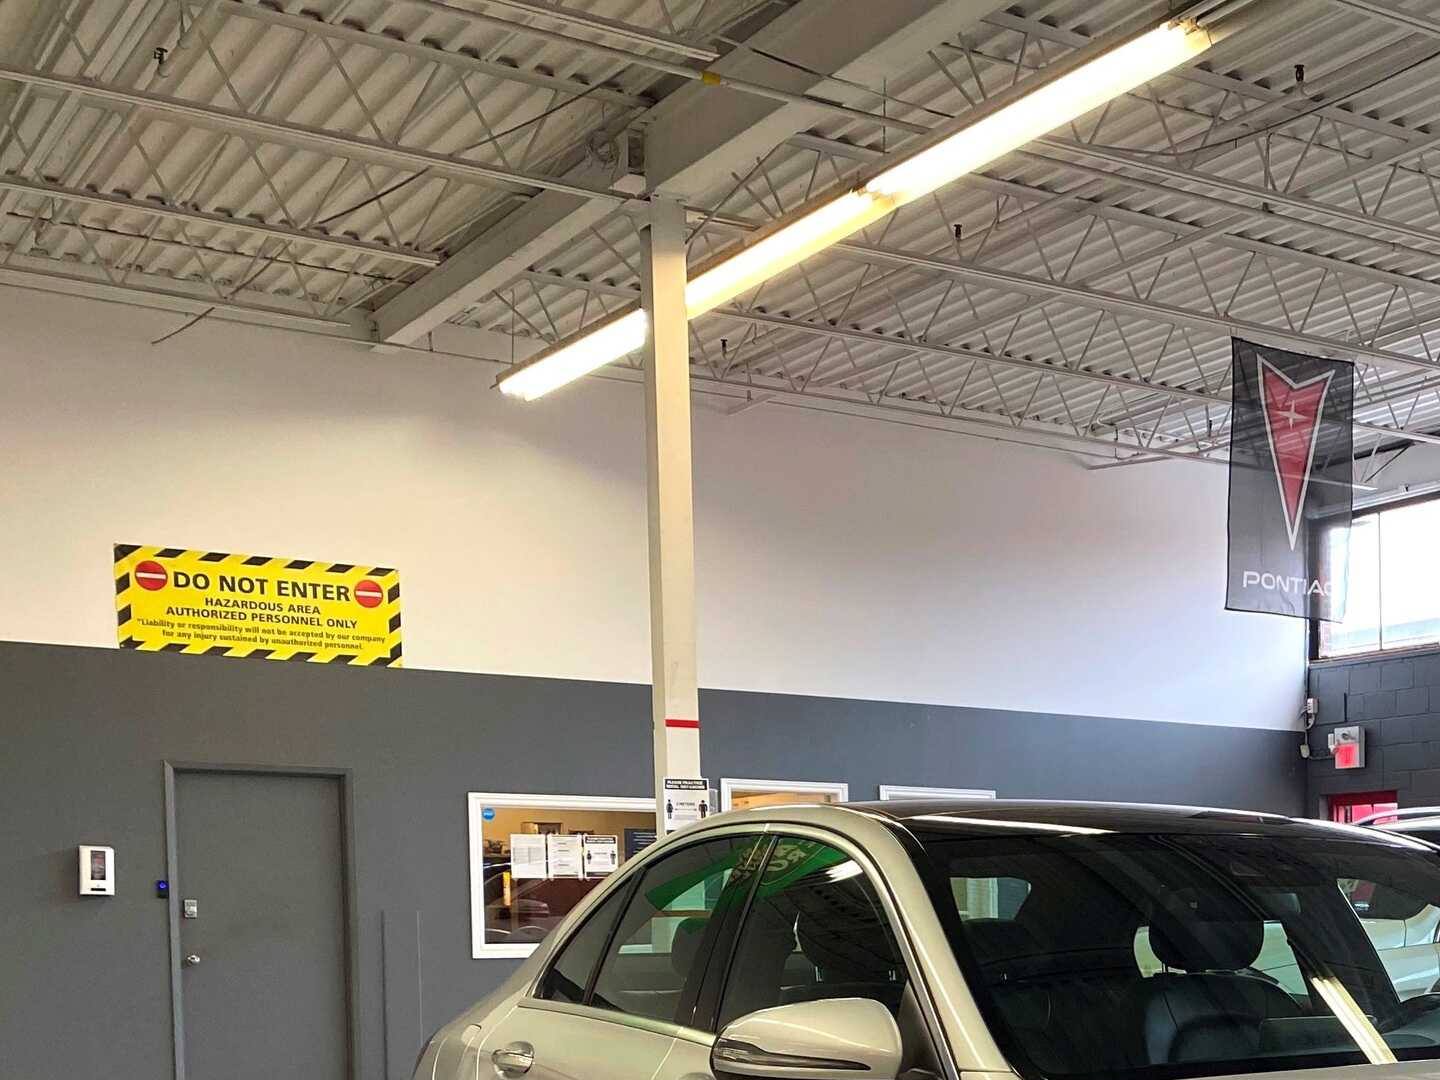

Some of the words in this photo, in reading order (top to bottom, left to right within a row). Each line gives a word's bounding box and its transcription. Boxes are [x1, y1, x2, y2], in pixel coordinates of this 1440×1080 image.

[173, 571, 210, 590] DO
[219, 575, 268, 595] NOT
[277, 580, 351, 601] ENTER
[205, 597, 283, 612] HAZARDOUS
[288, 604, 321, 615] AREA
[166, 607, 247, 621] AUTHORIZED
[252, 613, 322, 626] PERSONNEL
[327, 618, 358, 629] ONLY
[162, 629, 174, 637] for
[177, 631, 191, 640] any
[194, 631, 217, 641] injury
[219, 633, 257, 643] sustained
[259, 636, 269, 645] by
[271, 637, 322, 648] unauthorized
[188, 623, 243, 634] responsibility
[289, 630, 323, 640] accepted
[326, 632, 335, 640] by
[352, 635, 385, 644] company
